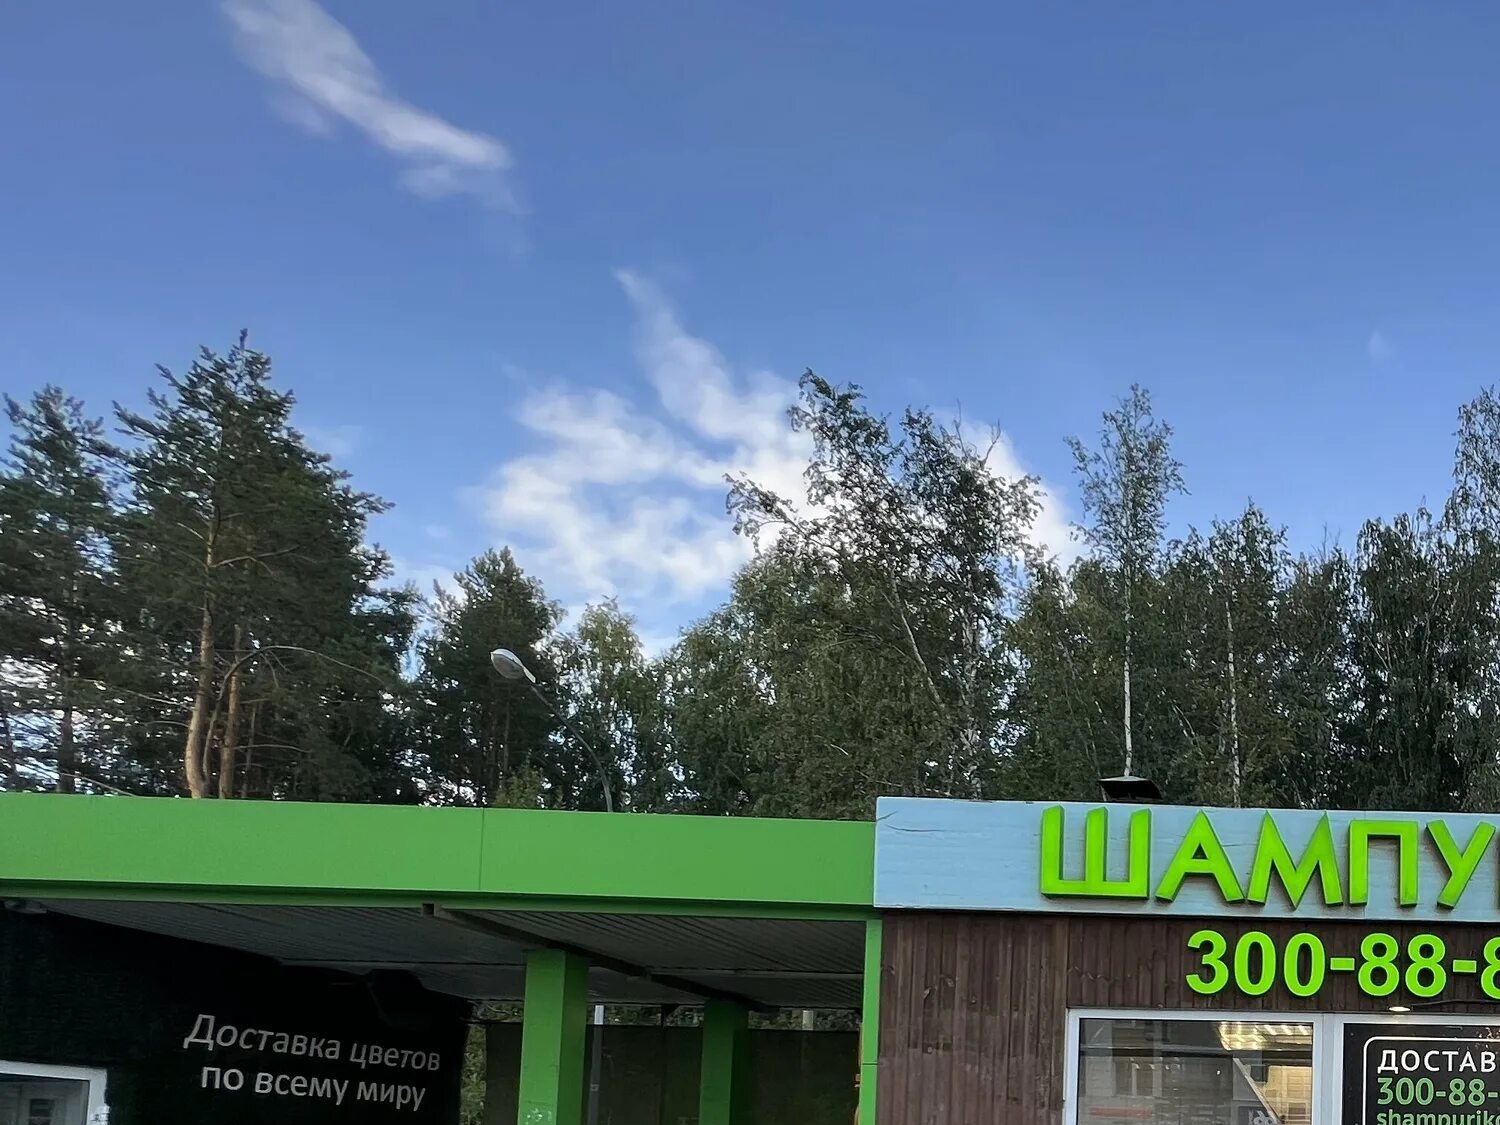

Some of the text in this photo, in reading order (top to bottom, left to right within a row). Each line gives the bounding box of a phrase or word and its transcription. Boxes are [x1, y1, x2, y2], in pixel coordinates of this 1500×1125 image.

[183, 1013, 441, 1071] Доставка цветов
[201, 1066, 426, 1112] по всему миру
